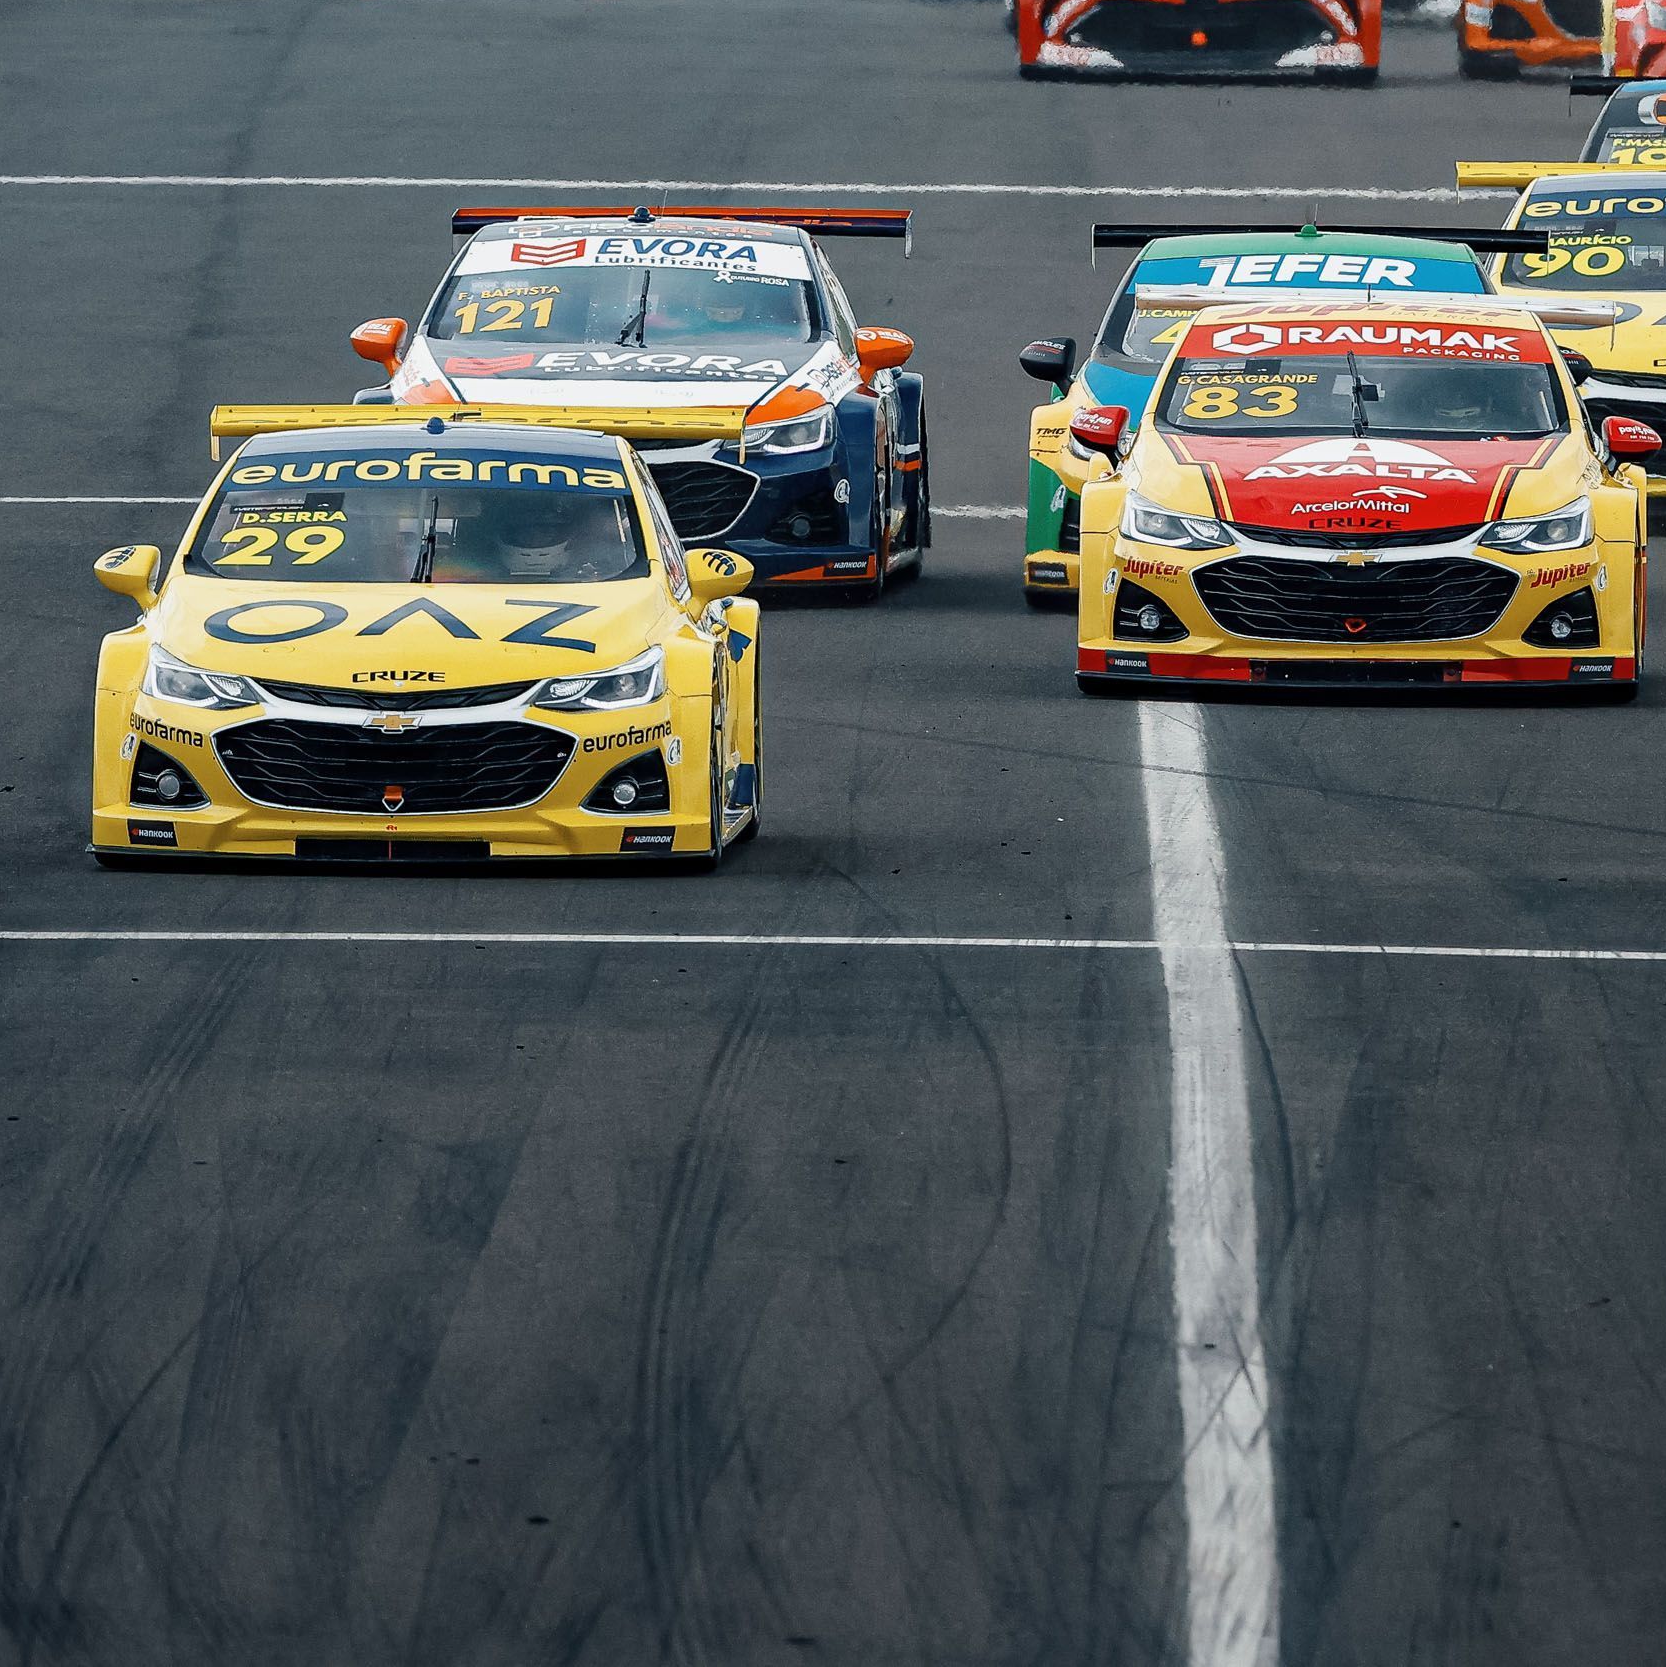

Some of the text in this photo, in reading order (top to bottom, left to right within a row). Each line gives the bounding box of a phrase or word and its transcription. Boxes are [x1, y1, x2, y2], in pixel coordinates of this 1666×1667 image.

[597, 238, 757, 263] EVORA
[1522, 245, 1625, 278] 90
[595, 256, 756, 272] Lubrificantes
[481, 286, 561, 299] BAPTISTA
[761, 277, 790, 287] ROSA
[454, 297, 554, 334] 121
[1289, 326, 1520, 353] RAUMAK
[536, 352, 789, 376] EVORA
[1403, 347, 1520, 361] PACKAGING
[1178, 374, 1318, 385] G.CASAGRANDE
[1183, 386, 1298, 419] 83
[232, 452, 627, 489] eurofarma
[1243, 464, 1477, 484] AXALTA
[242, 511, 347, 523] D.SERRA
[1291, 499, 1410, 514] ArcelorMittal
[1308, 517, 1402, 530] CRUZE
[212, 526, 345, 565] 29
[352, 671, 446, 683] CRUZE
[129, 712, 204, 748] eurofarma
[583, 721, 673, 753] eurofarma
